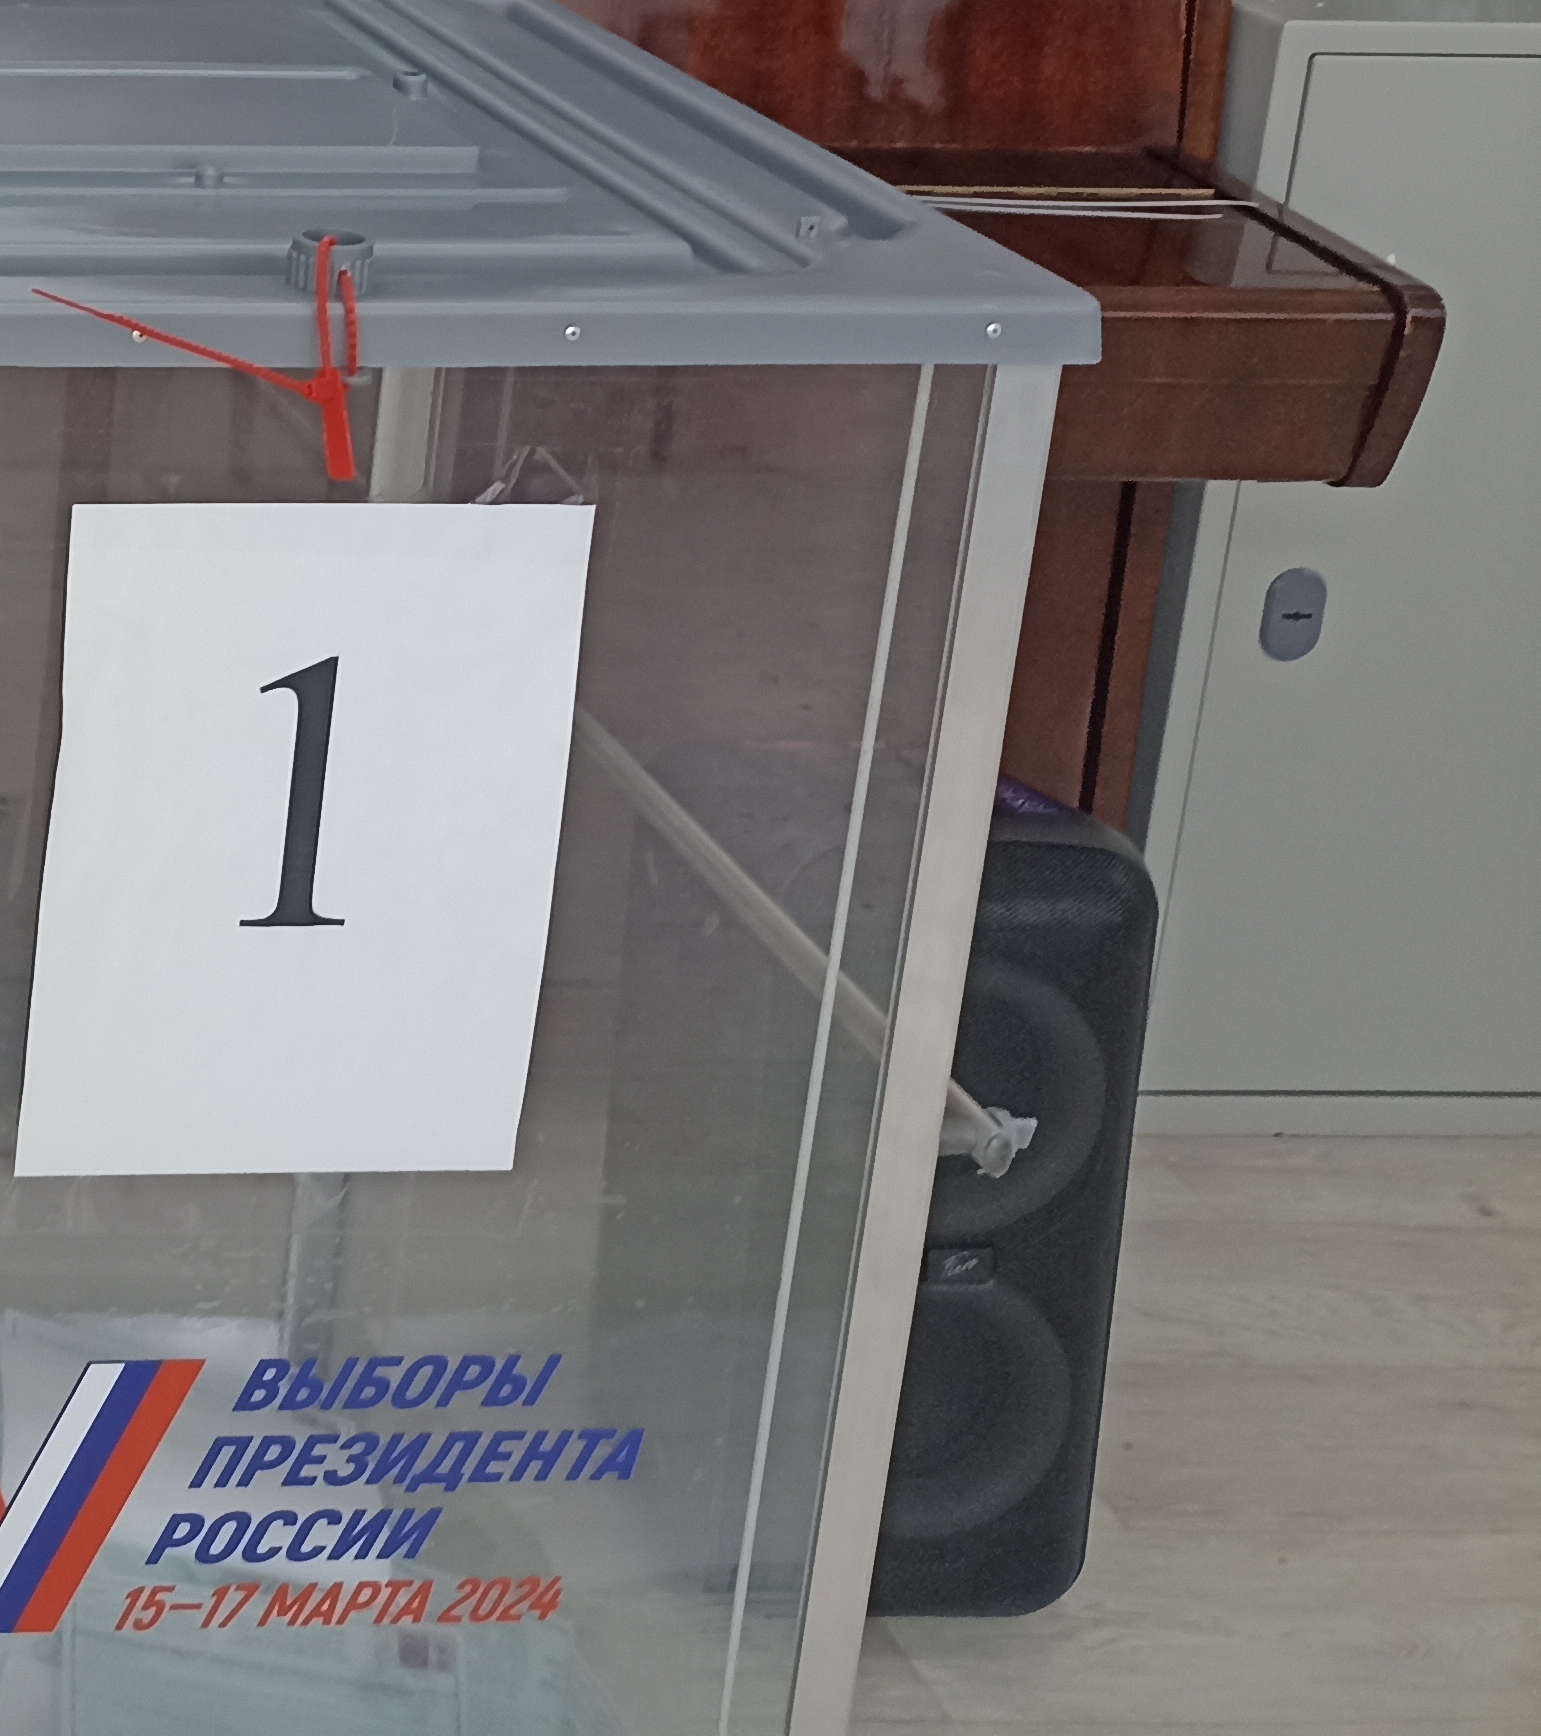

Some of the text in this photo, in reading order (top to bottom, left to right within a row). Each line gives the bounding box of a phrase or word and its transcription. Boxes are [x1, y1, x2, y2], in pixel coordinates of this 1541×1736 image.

[239, 655, 346, 927] 1
[232, 1353, 563, 1413] ВЫБОРЫ
[188, 1427, 646, 1492] ПРЕЗИДЕНТА
[146, 1507, 443, 1566] РОССИИ
[258, 1579, 436, 1628] МАРТА
[436, 1575, 564, 1625] 2024
